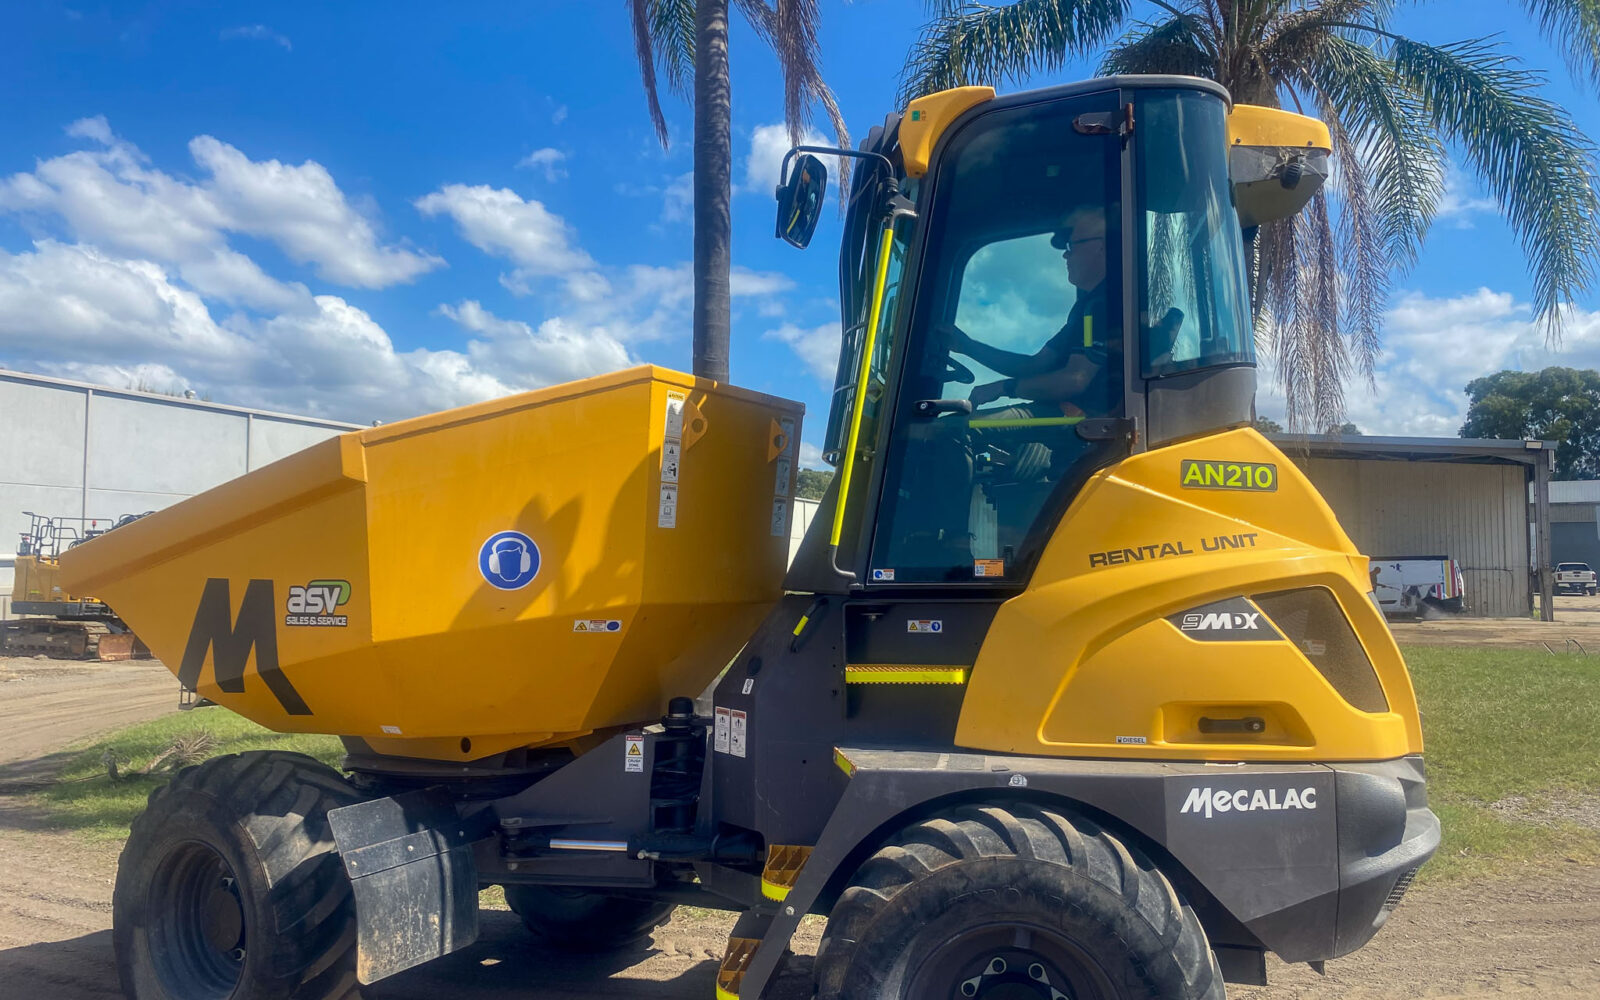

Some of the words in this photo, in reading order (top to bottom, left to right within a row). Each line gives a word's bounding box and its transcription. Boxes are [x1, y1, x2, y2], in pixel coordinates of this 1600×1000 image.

[1183, 463, 1273, 488] AN210
[1089, 541, 1194, 568] RENTAL
[1201, 533, 1258, 552] UNIT
[310, 616, 317, 625] &
[317, 616, 347, 626] SERVICE
[1180, 612, 1260, 631] 9MDX
